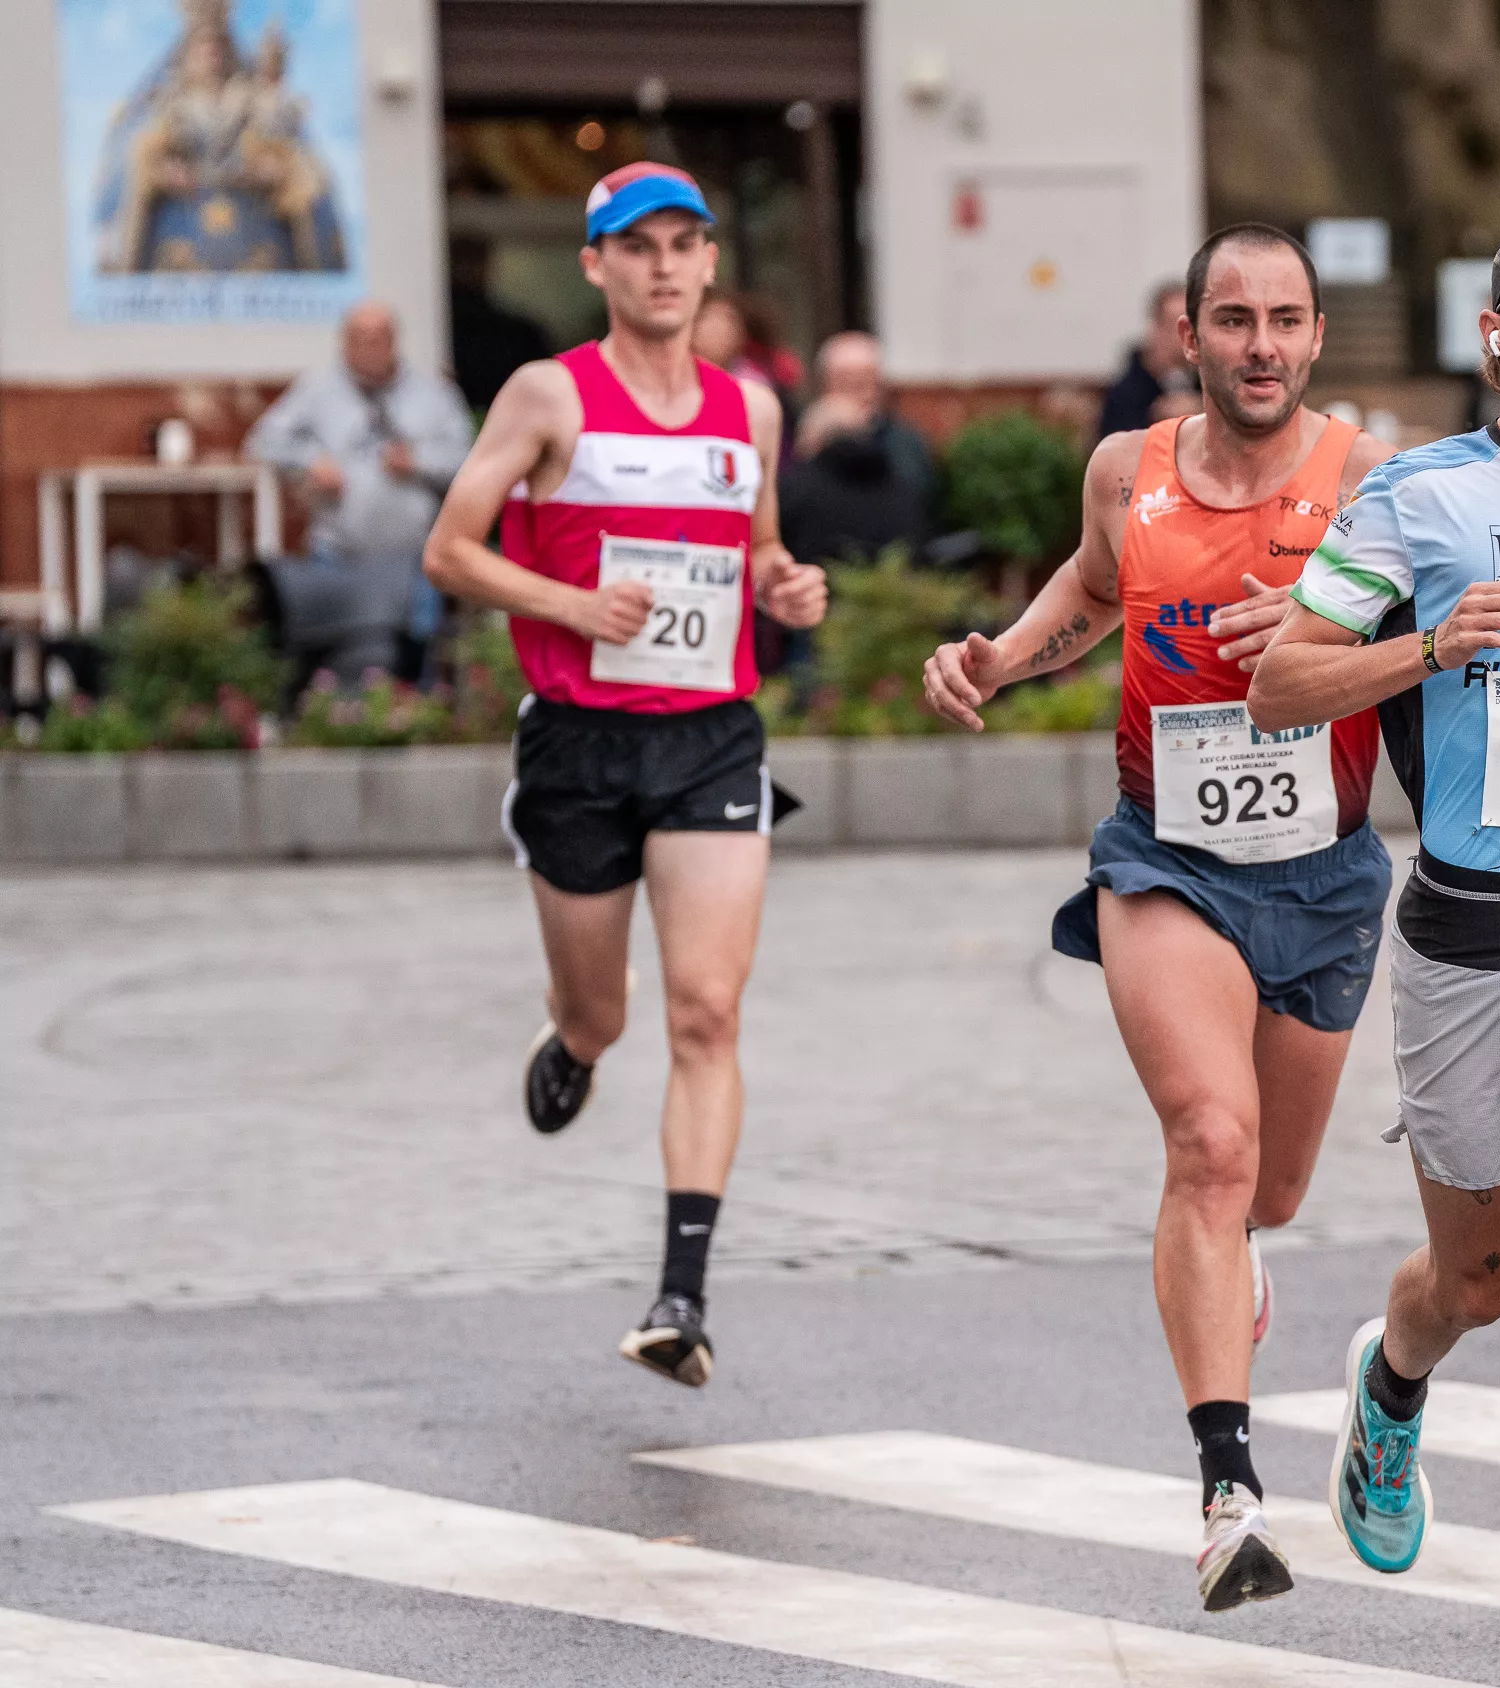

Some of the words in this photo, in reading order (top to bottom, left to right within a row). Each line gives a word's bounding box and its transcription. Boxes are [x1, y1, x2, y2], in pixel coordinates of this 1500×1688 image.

[1229, 752, 1255, 761] CIUDAD
[1266, 750, 1294, 758] LUCENA
[1242, 761, 1278, 769] IGUALDAD
[1197, 772, 1299, 826] 923
